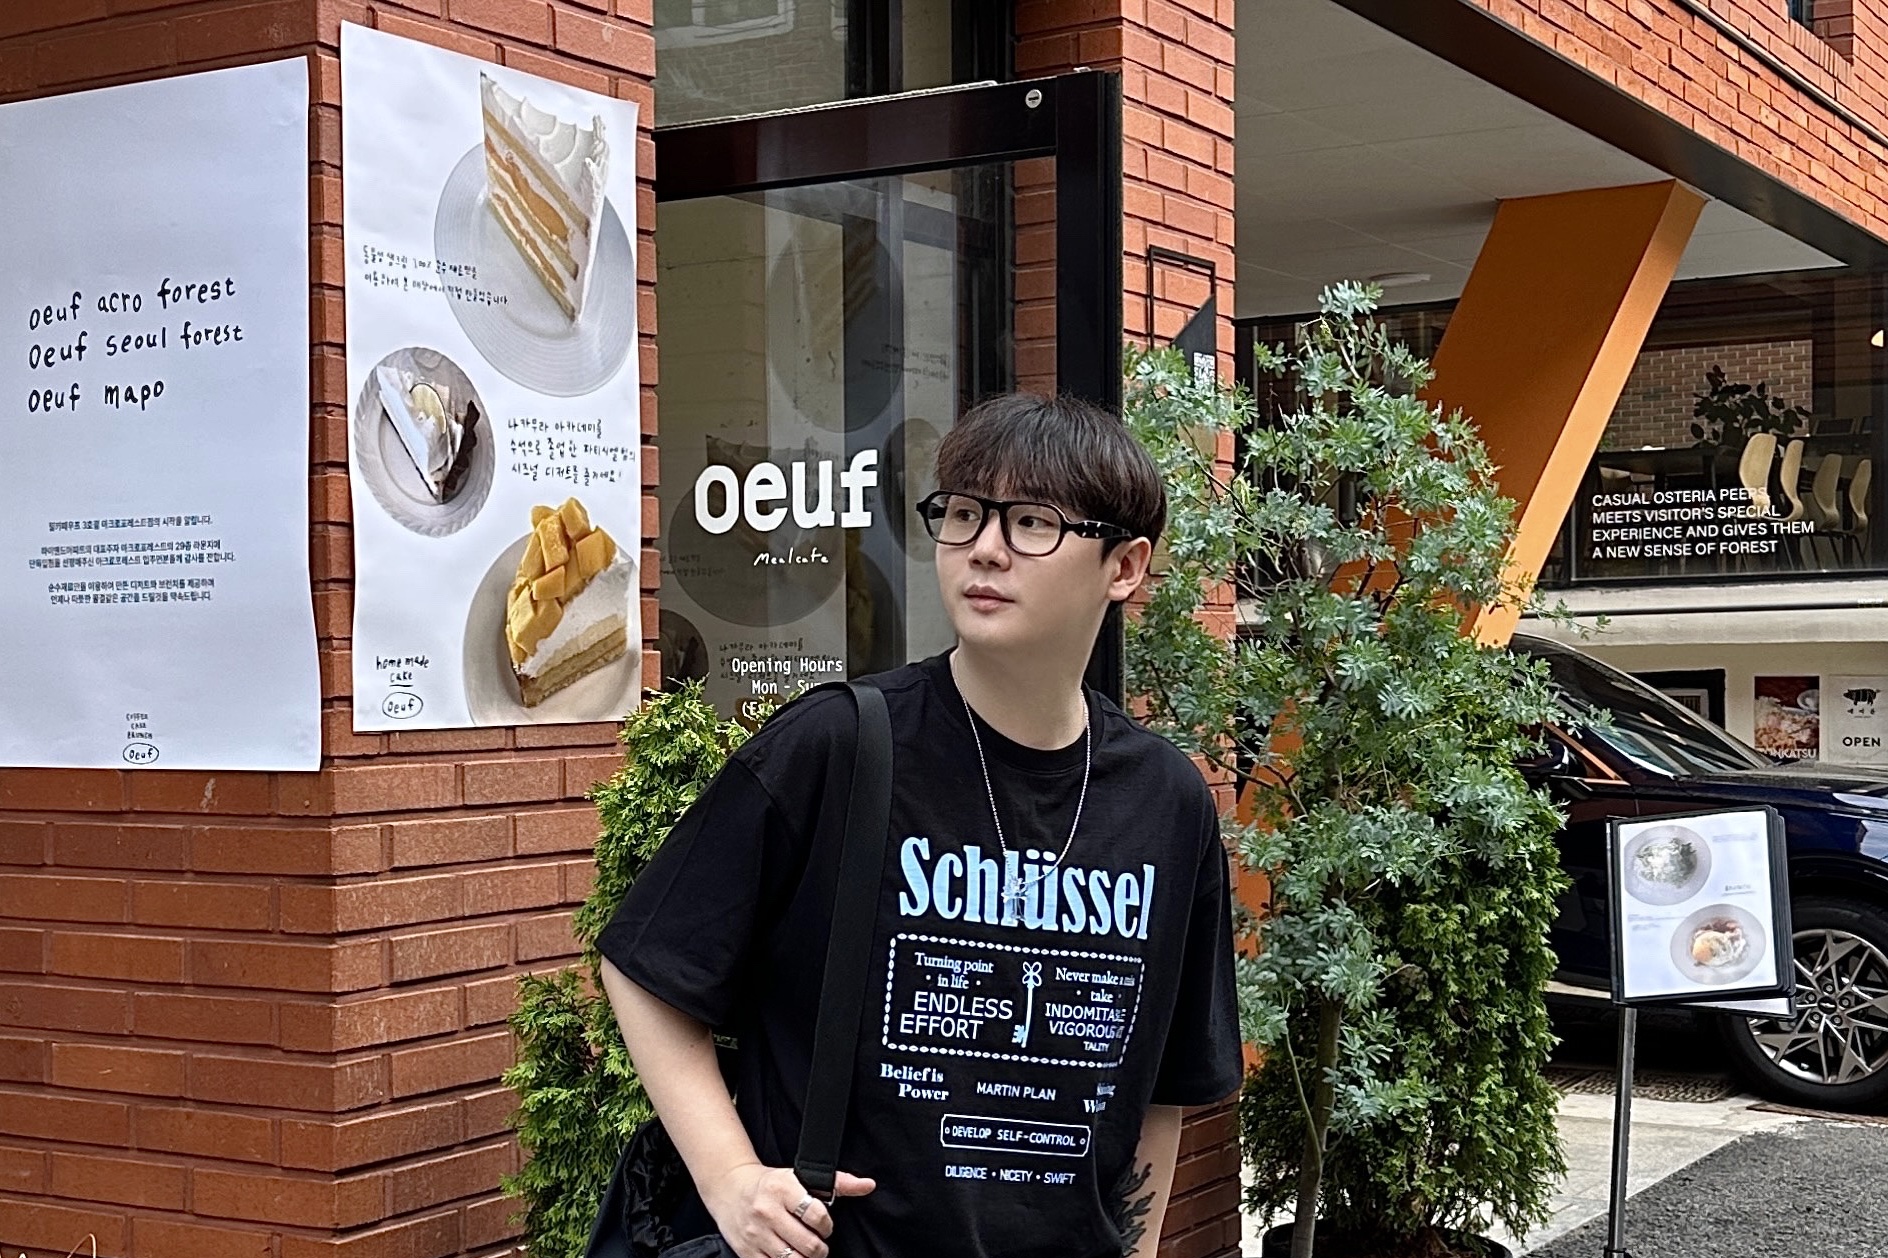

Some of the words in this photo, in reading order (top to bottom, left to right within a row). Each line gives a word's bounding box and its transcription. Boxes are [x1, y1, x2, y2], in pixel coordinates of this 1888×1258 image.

[97, 292, 142, 313] acro
[157, 277, 236, 309] forest
[106, 327, 166, 356] seoul
[180, 321, 244, 350] forest
[104, 380, 165, 411] mapo
[508, 418, 549, 433] 나카무라
[555, 419, 602, 439] 아카데미를
[510, 439, 542, 456] 수석으로
[512, 463, 538, 481] 시즈널
[546, 465, 578, 484] 디저트를
[695, 449, 878, 534] oeuf
[1592, 493, 1650, 507] CASUAL
[1654, 490, 1716, 504] OSTERIA
[1592, 510, 1641, 524] MEETS
[1644, 507, 1714, 522] VISITOR'S
[1718, 505, 1781, 518] SPECIAL
[1592, 526, 1682, 542] EXPERIENCE
[1686, 524, 1719, 538] AND
[1722, 522, 1768, 536] GIVES
[1771, 521, 1814, 534] THEM
[754, 547, 829, 566] Mealcafe
[1592, 547, 1603, 559] A
[1606, 546, 1641, 558] NEW
[1644, 543, 1692, 557] SENSE
[1695, 542, 1716, 556] OF
[1720, 540, 1778, 554] FOREST
[732, 658, 792, 676] Opening
[800, 658, 843, 672] Hours
[752, 680, 778, 694] Mon
[1842, 736, 1881, 747] OPEN
[899, 836, 1155, 940] Schlüssel
[914, 952, 962, 974] Turning
[963, 959, 994, 975] point
[937, 974, 949, 988] in
[950, 974, 970, 989] life
[1055, 966, 1091, 982] Never
[1092, 970, 1119, 985] make
[914, 990, 1013, 1020] ENDLESS
[1090, 988, 1114, 1003] take
[900, 1013, 984, 1040] EFFORT
[880, 1062, 930, 1082] Belief
[931, 1068, 944, 1083] is
[898, 1083, 950, 1101] Power
[976, 1082, 1020, 1098] MARTIN
[1022, 1086, 1056, 1101] PLAN
[952, 1125, 992, 1140] DEVELOP
[996, 1128, 1076, 1146] SELF-CONTROL
[945, 1165, 988, 1180] DILIGENCE
[1000, 1168, 1033, 1182] NICETY
[1044, 1172, 1076, 1184] SWIFT
